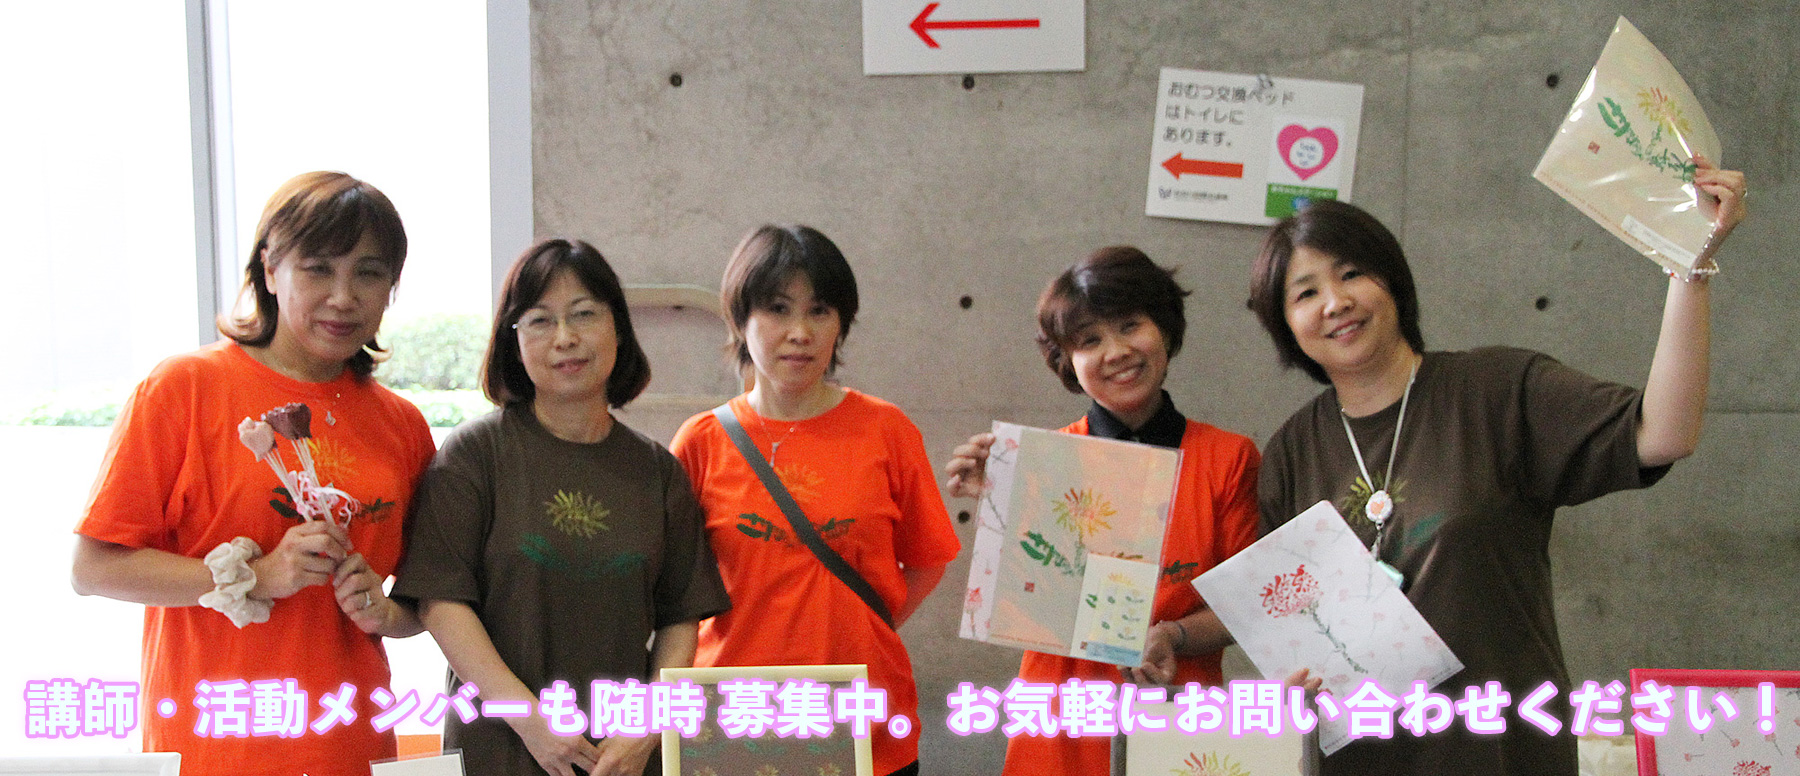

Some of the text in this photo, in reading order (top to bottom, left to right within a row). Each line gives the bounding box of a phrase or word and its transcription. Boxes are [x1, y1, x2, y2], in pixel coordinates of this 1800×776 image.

[1164, 103, 1244, 126] はトイレに
